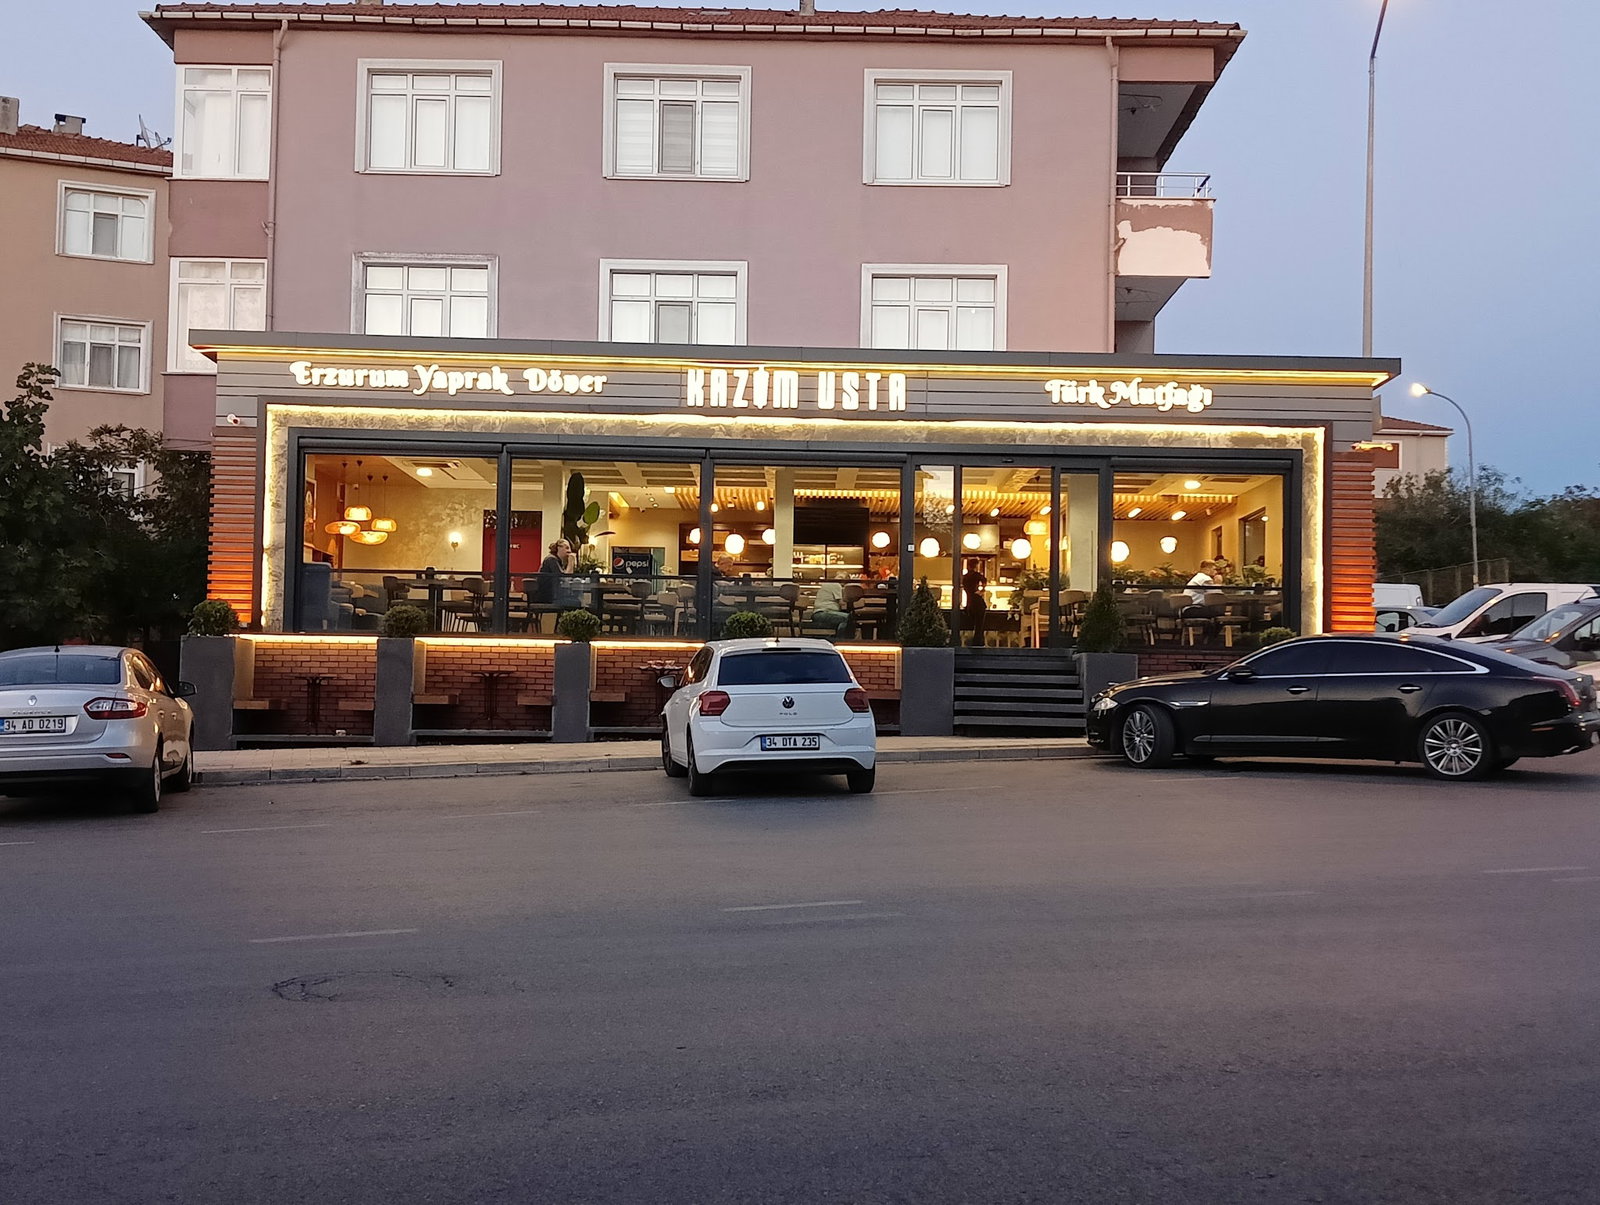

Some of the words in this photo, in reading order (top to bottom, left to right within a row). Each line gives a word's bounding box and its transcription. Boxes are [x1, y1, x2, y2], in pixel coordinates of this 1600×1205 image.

[289, 361, 410, 388] Erzurum
[412, 364, 515, 396] Yaprak
[522, 367, 608, 394] Döner
[817, 371, 906, 411] USTA
[1044, 379, 1111, 409] Türk
[625, 560, 649, 568] pepsi
[4, 720, 17, 731] 34
[22, 719, 34, 730] AD
[39, 718, 64, 729] 0219
[766, 737, 777, 747] 34
[782, 737, 798, 747] DTA
[801, 737, 817, 747] 235
